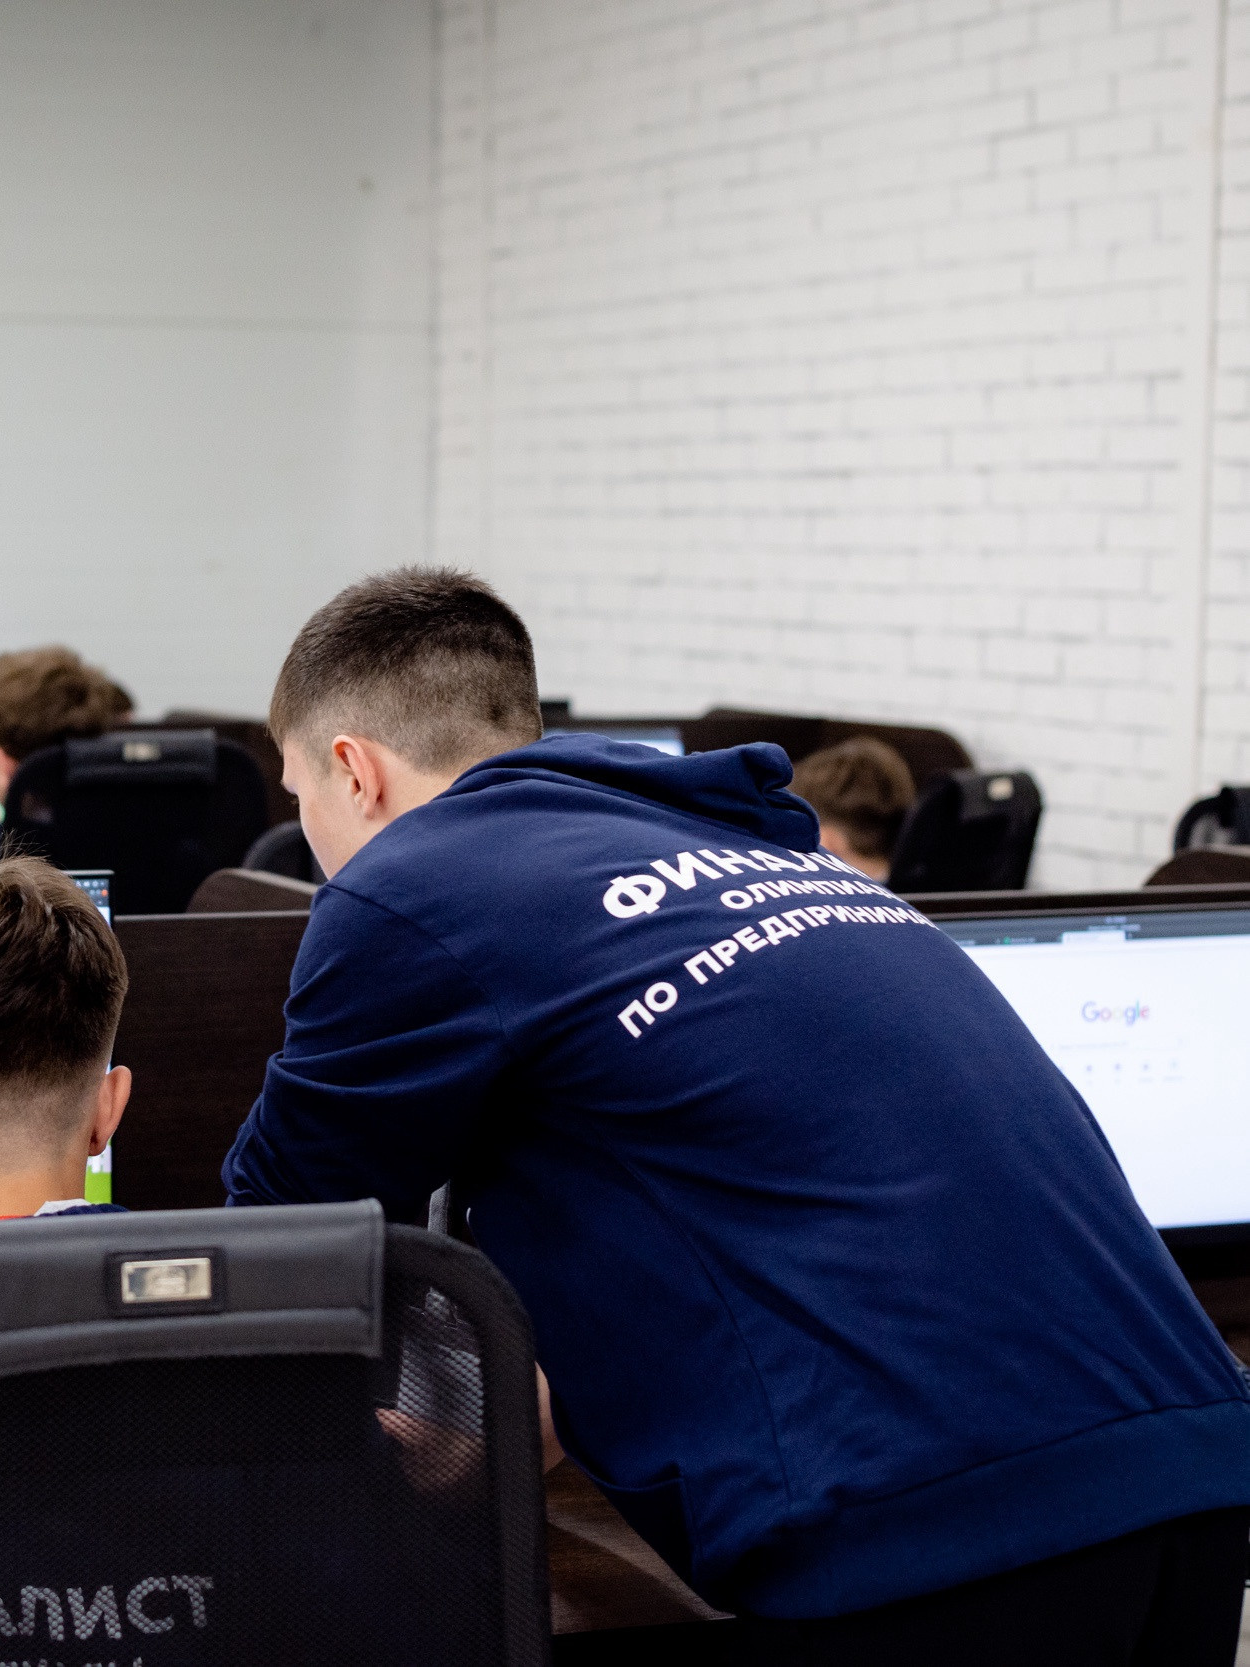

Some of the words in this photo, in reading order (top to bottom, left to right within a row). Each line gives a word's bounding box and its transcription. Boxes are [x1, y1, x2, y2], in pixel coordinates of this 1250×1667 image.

[602, 849, 873, 919] ФИНАЛИ
[617, 981, 678, 1038] ПО
[684, 905, 940, 985] ПРЕДПРИНИМА
[1081, 999, 1150, 1026] Google
